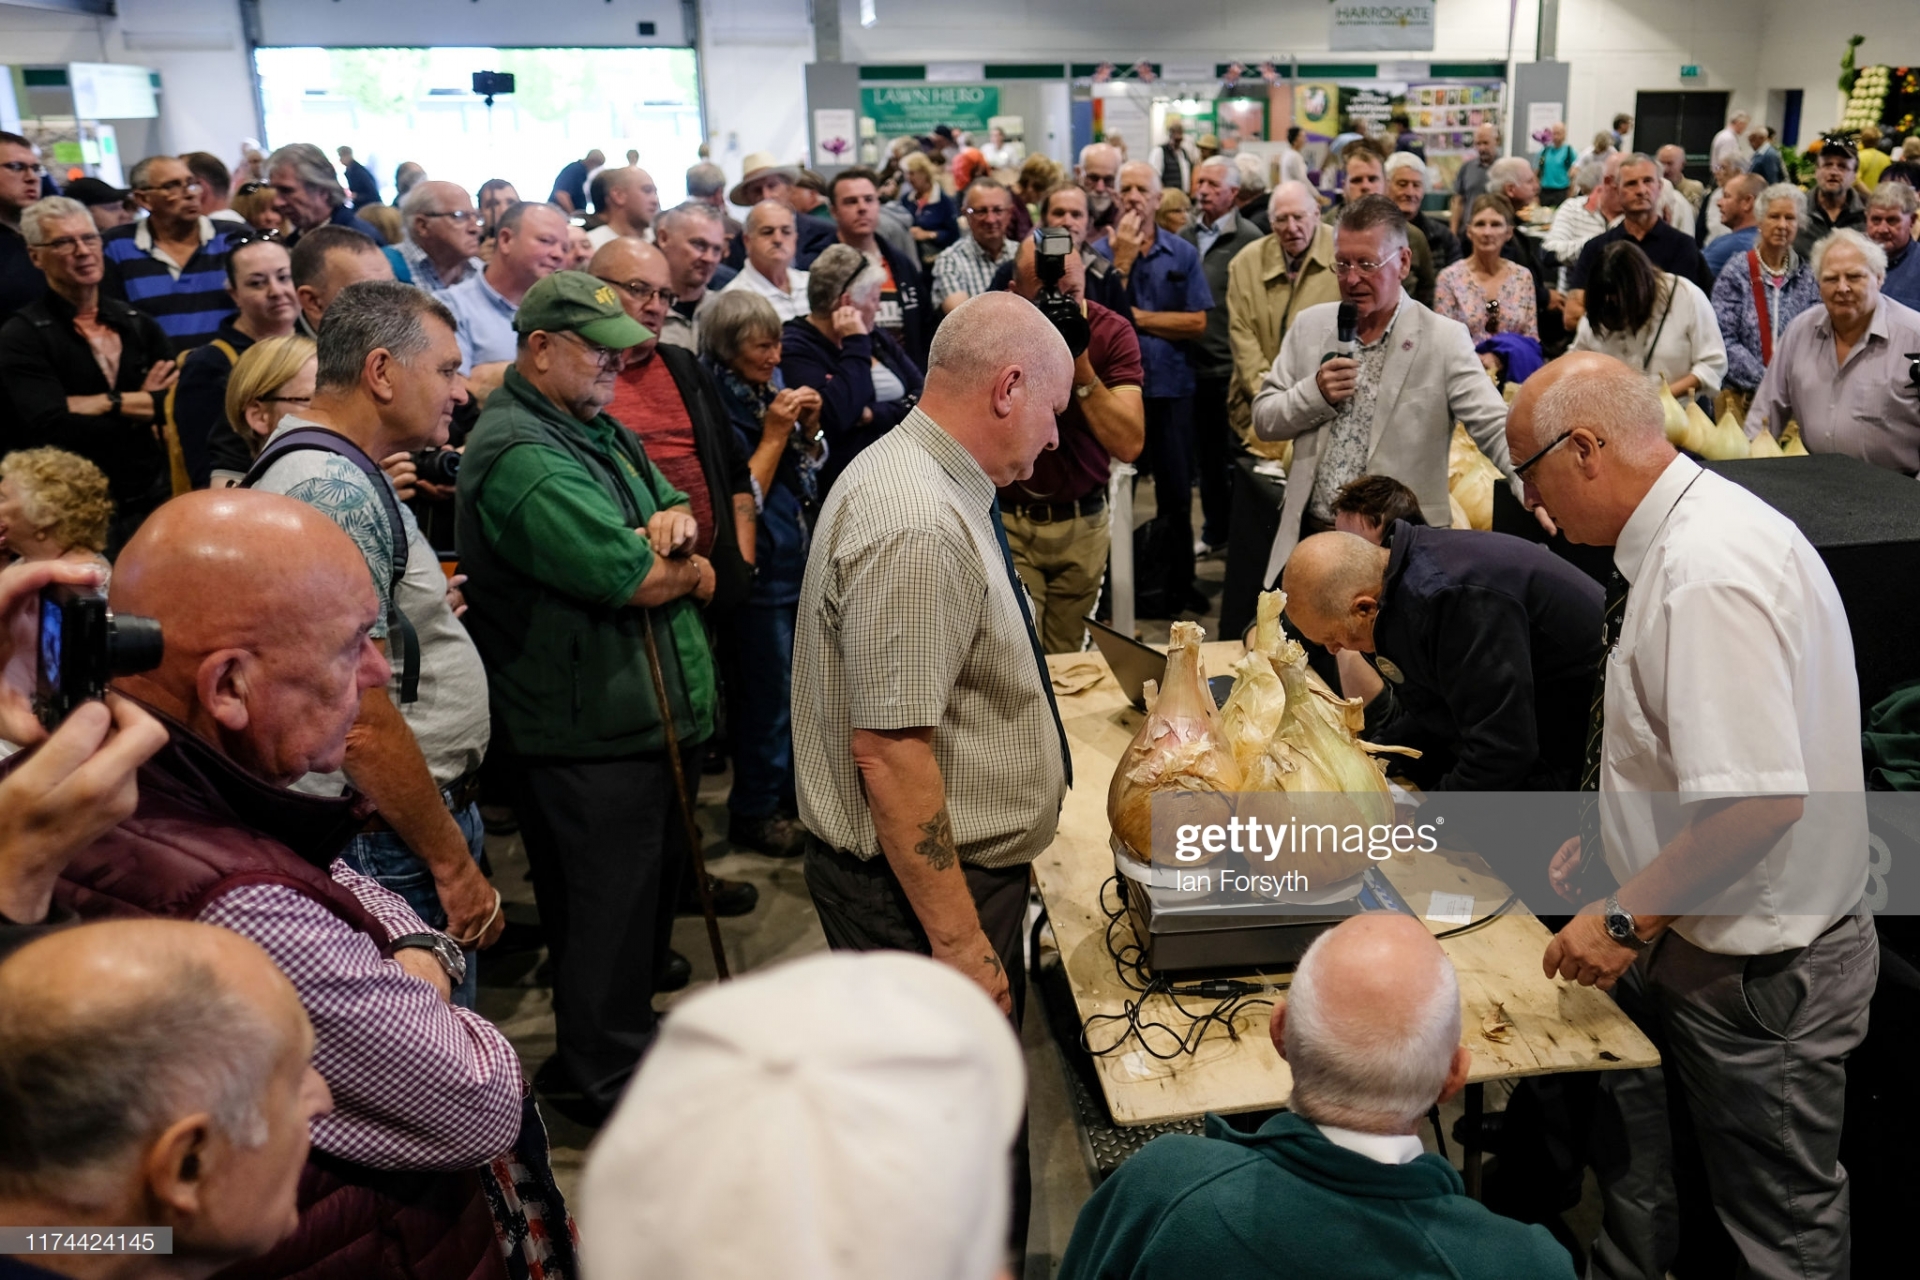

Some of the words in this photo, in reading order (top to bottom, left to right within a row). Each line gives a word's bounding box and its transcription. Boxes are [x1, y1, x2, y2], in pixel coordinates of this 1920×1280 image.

[1336, 7, 1430, 19] HARROGATE
[873, 89, 930, 105] LAWN
[932, 88, 985, 104] HERO
